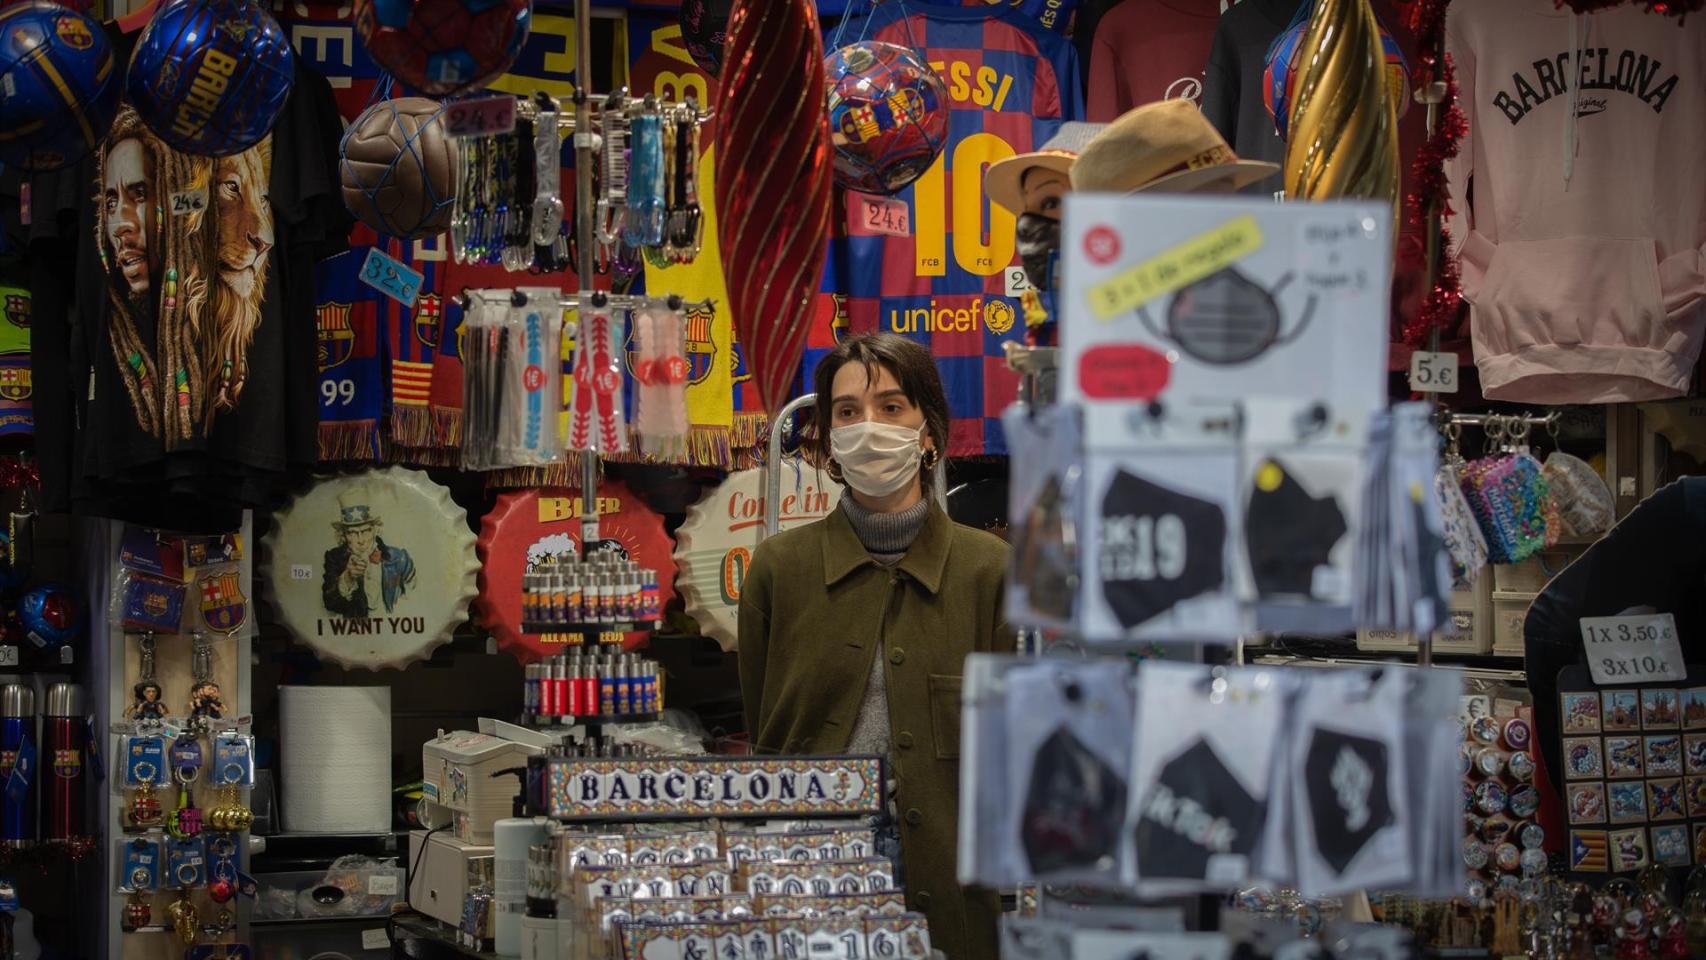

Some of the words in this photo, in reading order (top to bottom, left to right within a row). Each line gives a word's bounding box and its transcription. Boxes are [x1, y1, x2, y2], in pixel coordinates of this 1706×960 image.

[869, 203, 906, 232] 24.€
[921, 258, 940, 267] FCB
[890, 298, 981, 334] unicef
[1416, 358, 1452, 385] 5.€
[320, 378, 356, 407] 99
[804, 486, 830, 513] in
[317, 619, 323, 636] I
[329, 617, 383, 636] WANT
[388, 616, 425, 635] YOU
[579, 772, 827, 801] BARCELONA
